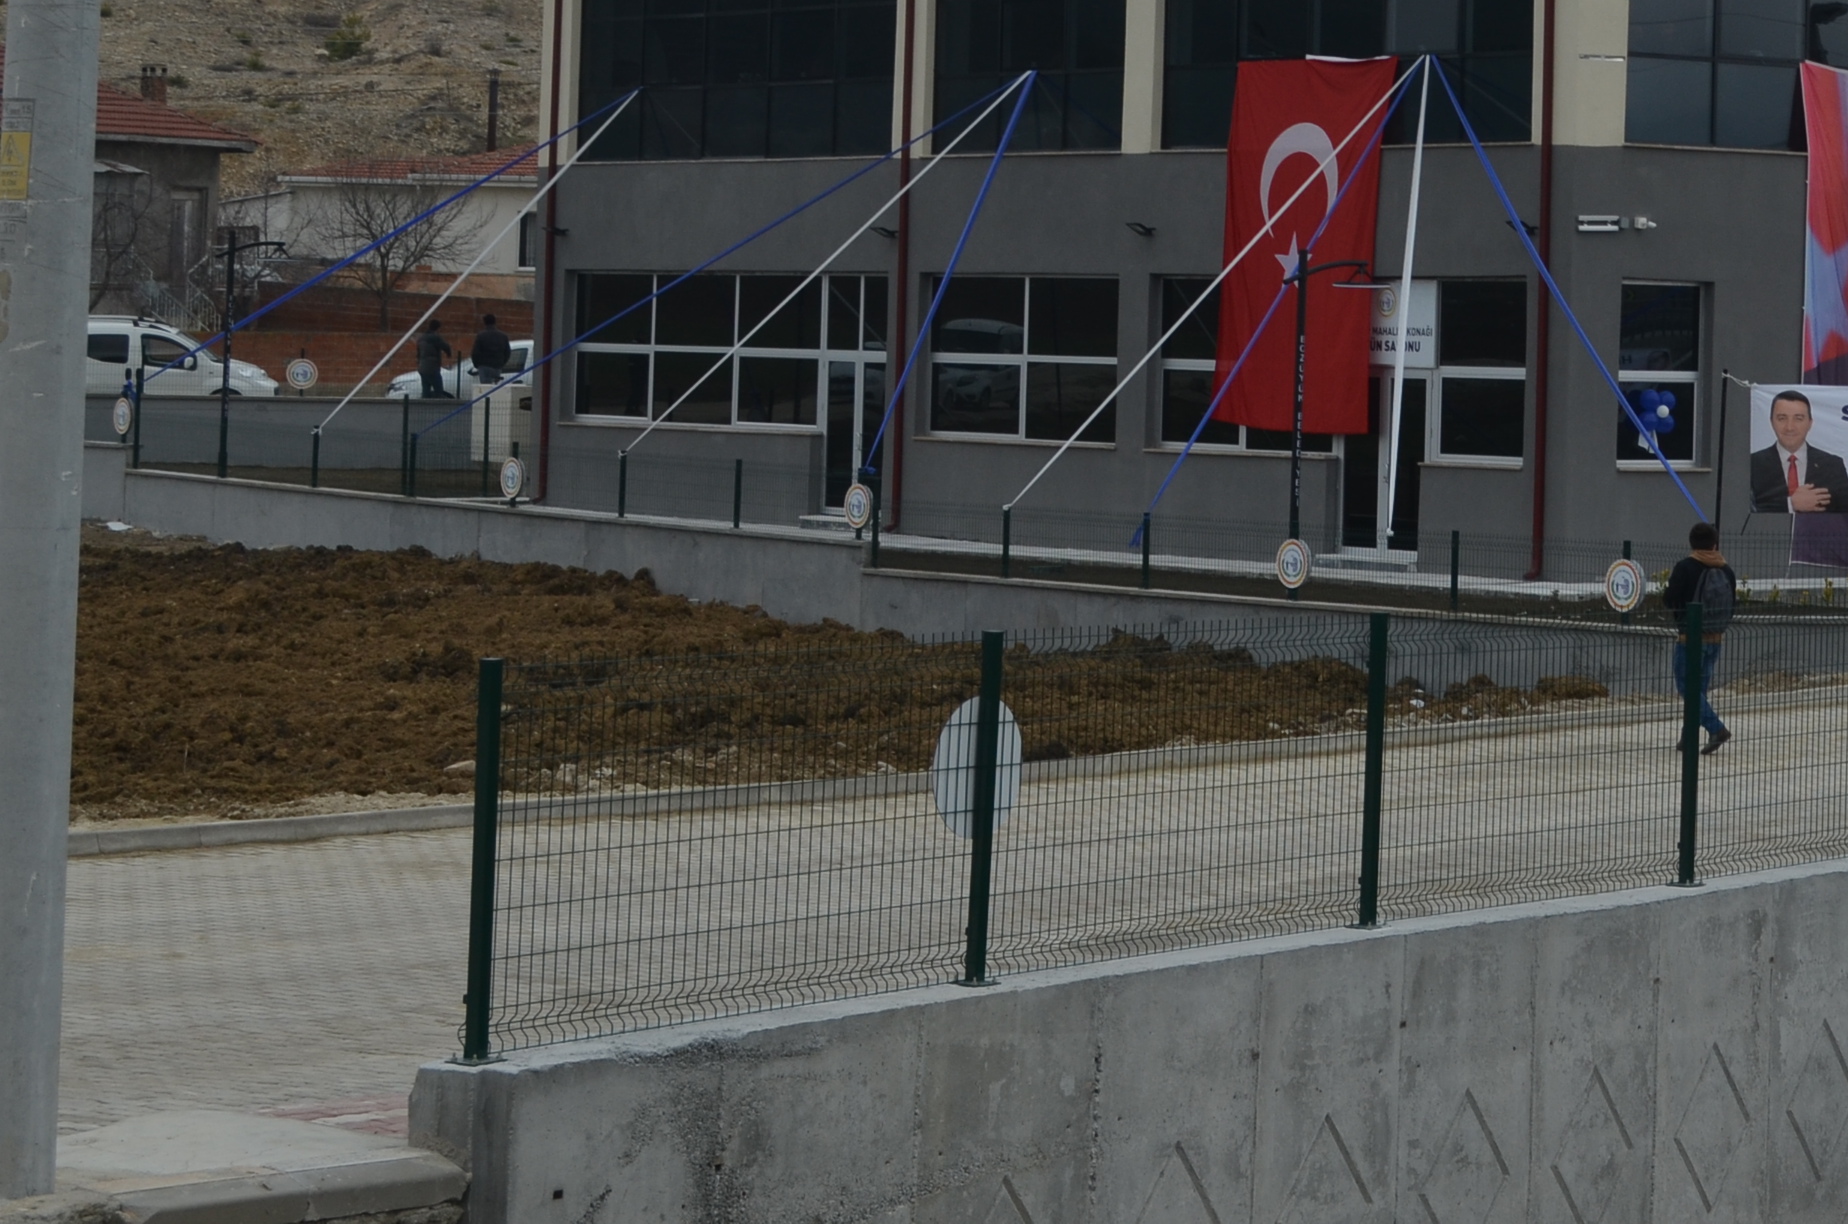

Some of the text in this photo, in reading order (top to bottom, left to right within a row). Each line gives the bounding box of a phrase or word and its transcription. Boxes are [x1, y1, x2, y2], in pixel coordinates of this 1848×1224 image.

[1372, 325, 1433, 337] MAHAL KONAĞI
[1384, 340, 1421, 352] SANU
